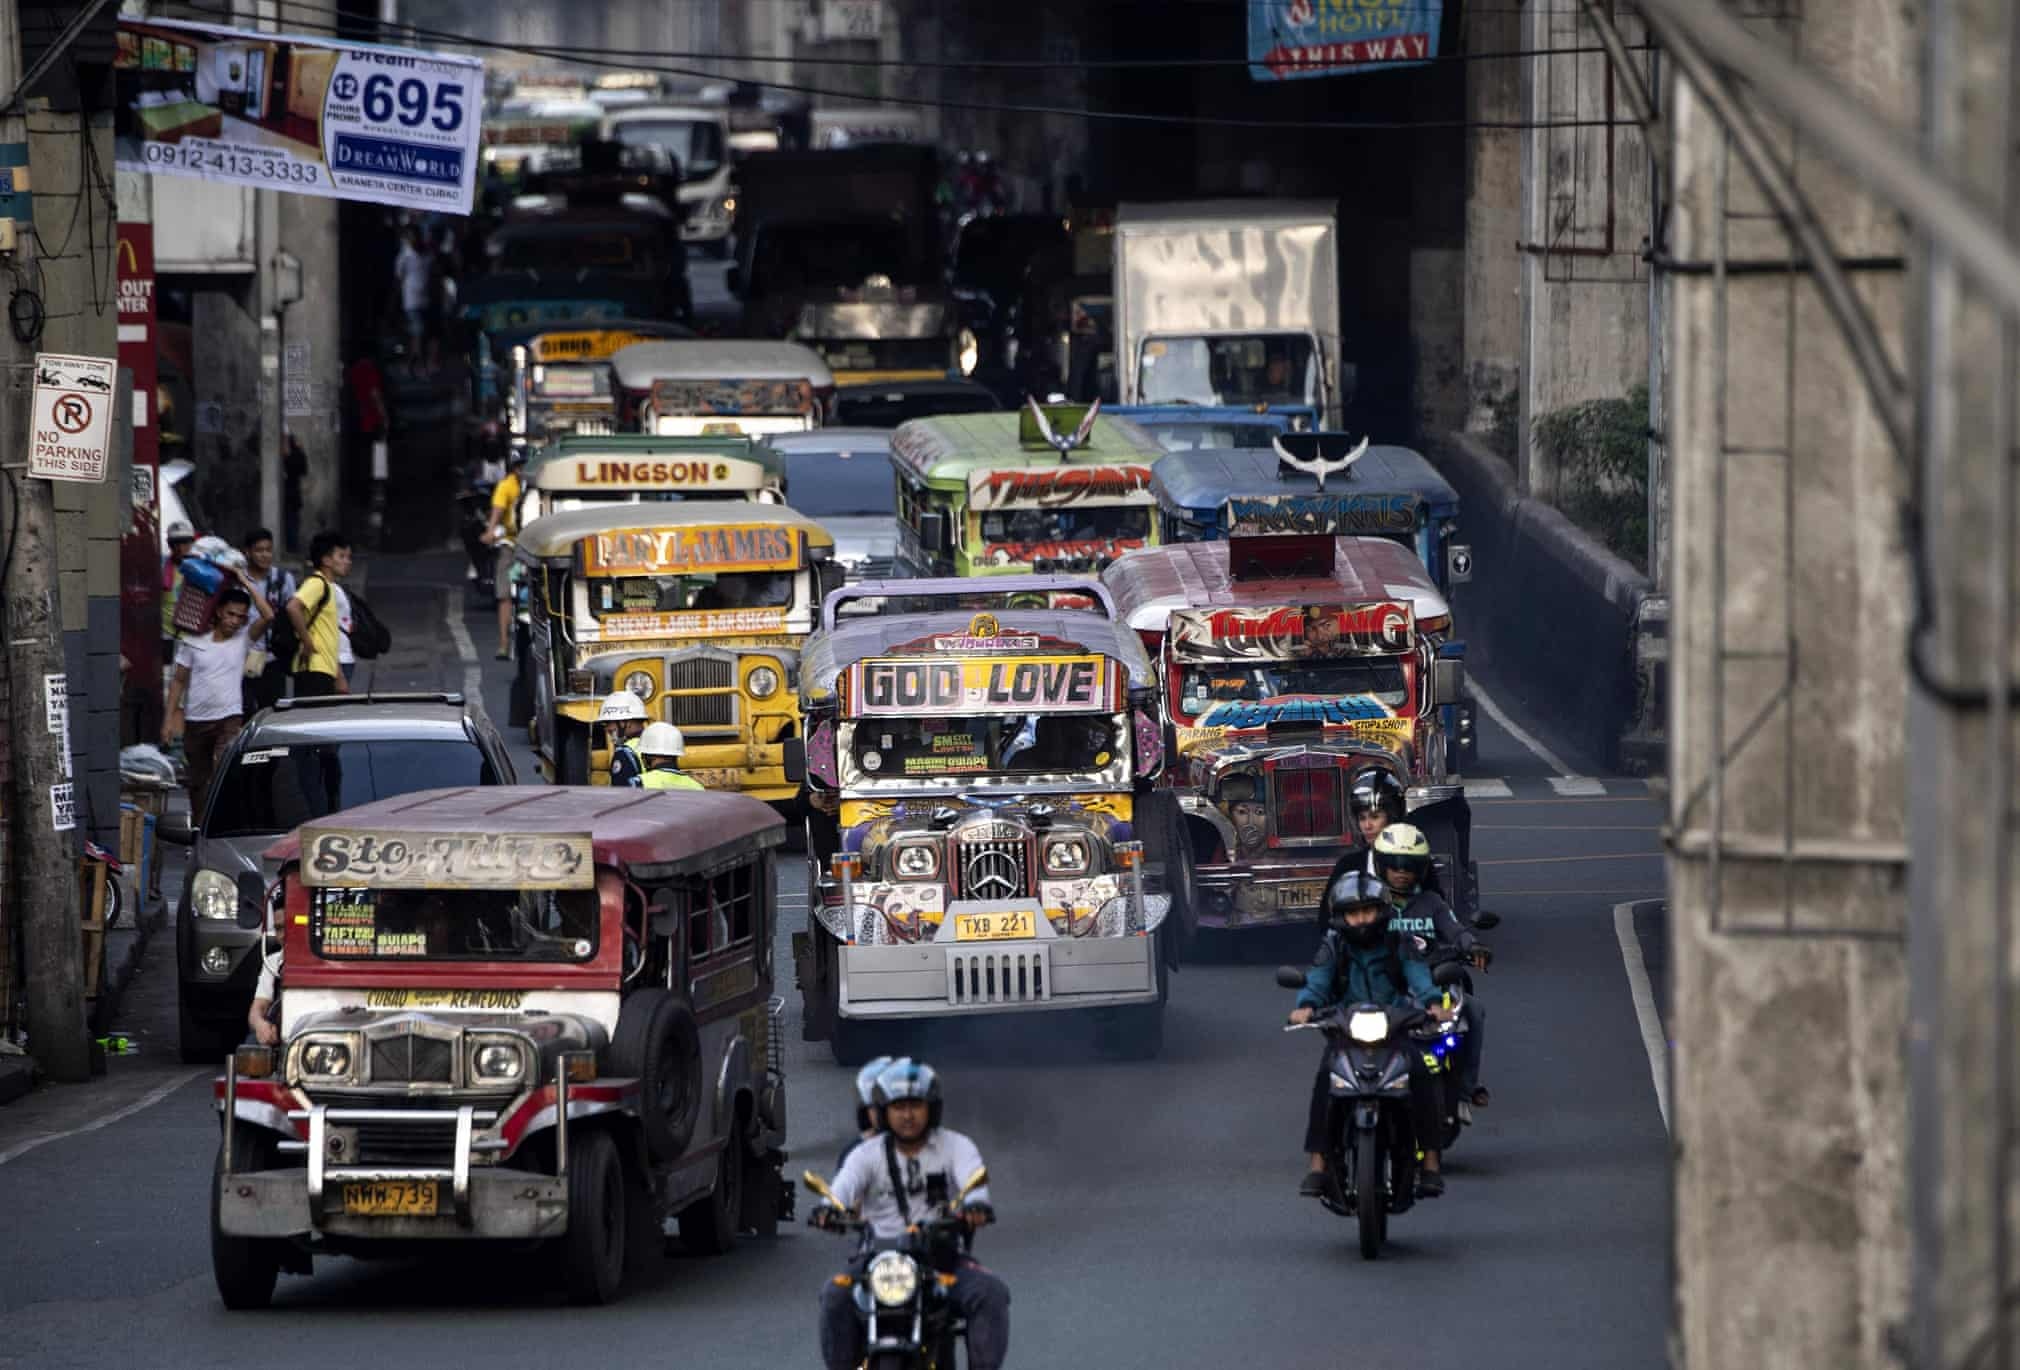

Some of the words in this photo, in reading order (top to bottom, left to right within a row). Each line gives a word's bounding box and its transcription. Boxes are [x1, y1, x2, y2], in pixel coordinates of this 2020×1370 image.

[1366, 36, 1426, 60] WAY
[362, 73, 464, 132] 695
[326, 111, 362, 123] PROMO
[146, 144, 318, 184] 0912-413-3333
[120, 279, 154, 297] OUT
[37, 431, 60, 444] NO
[35, 444, 102, 461] PARKING
[37, 458, 66, 470] THIS
[71, 461, 100, 473] SIDE
[577, 462, 710, 484] LINGSON
[693, 527, 792, 563] JAMES
[863, 665, 961, 706] GOD
[987, 662, 1095, 702] LOVE
[963, 918, 991, 935] TXB
[1000, 917, 1028, 932] 221
[449, 991, 522, 1009] REMEDIOS
[391, 1183, 434, 1205] 739
